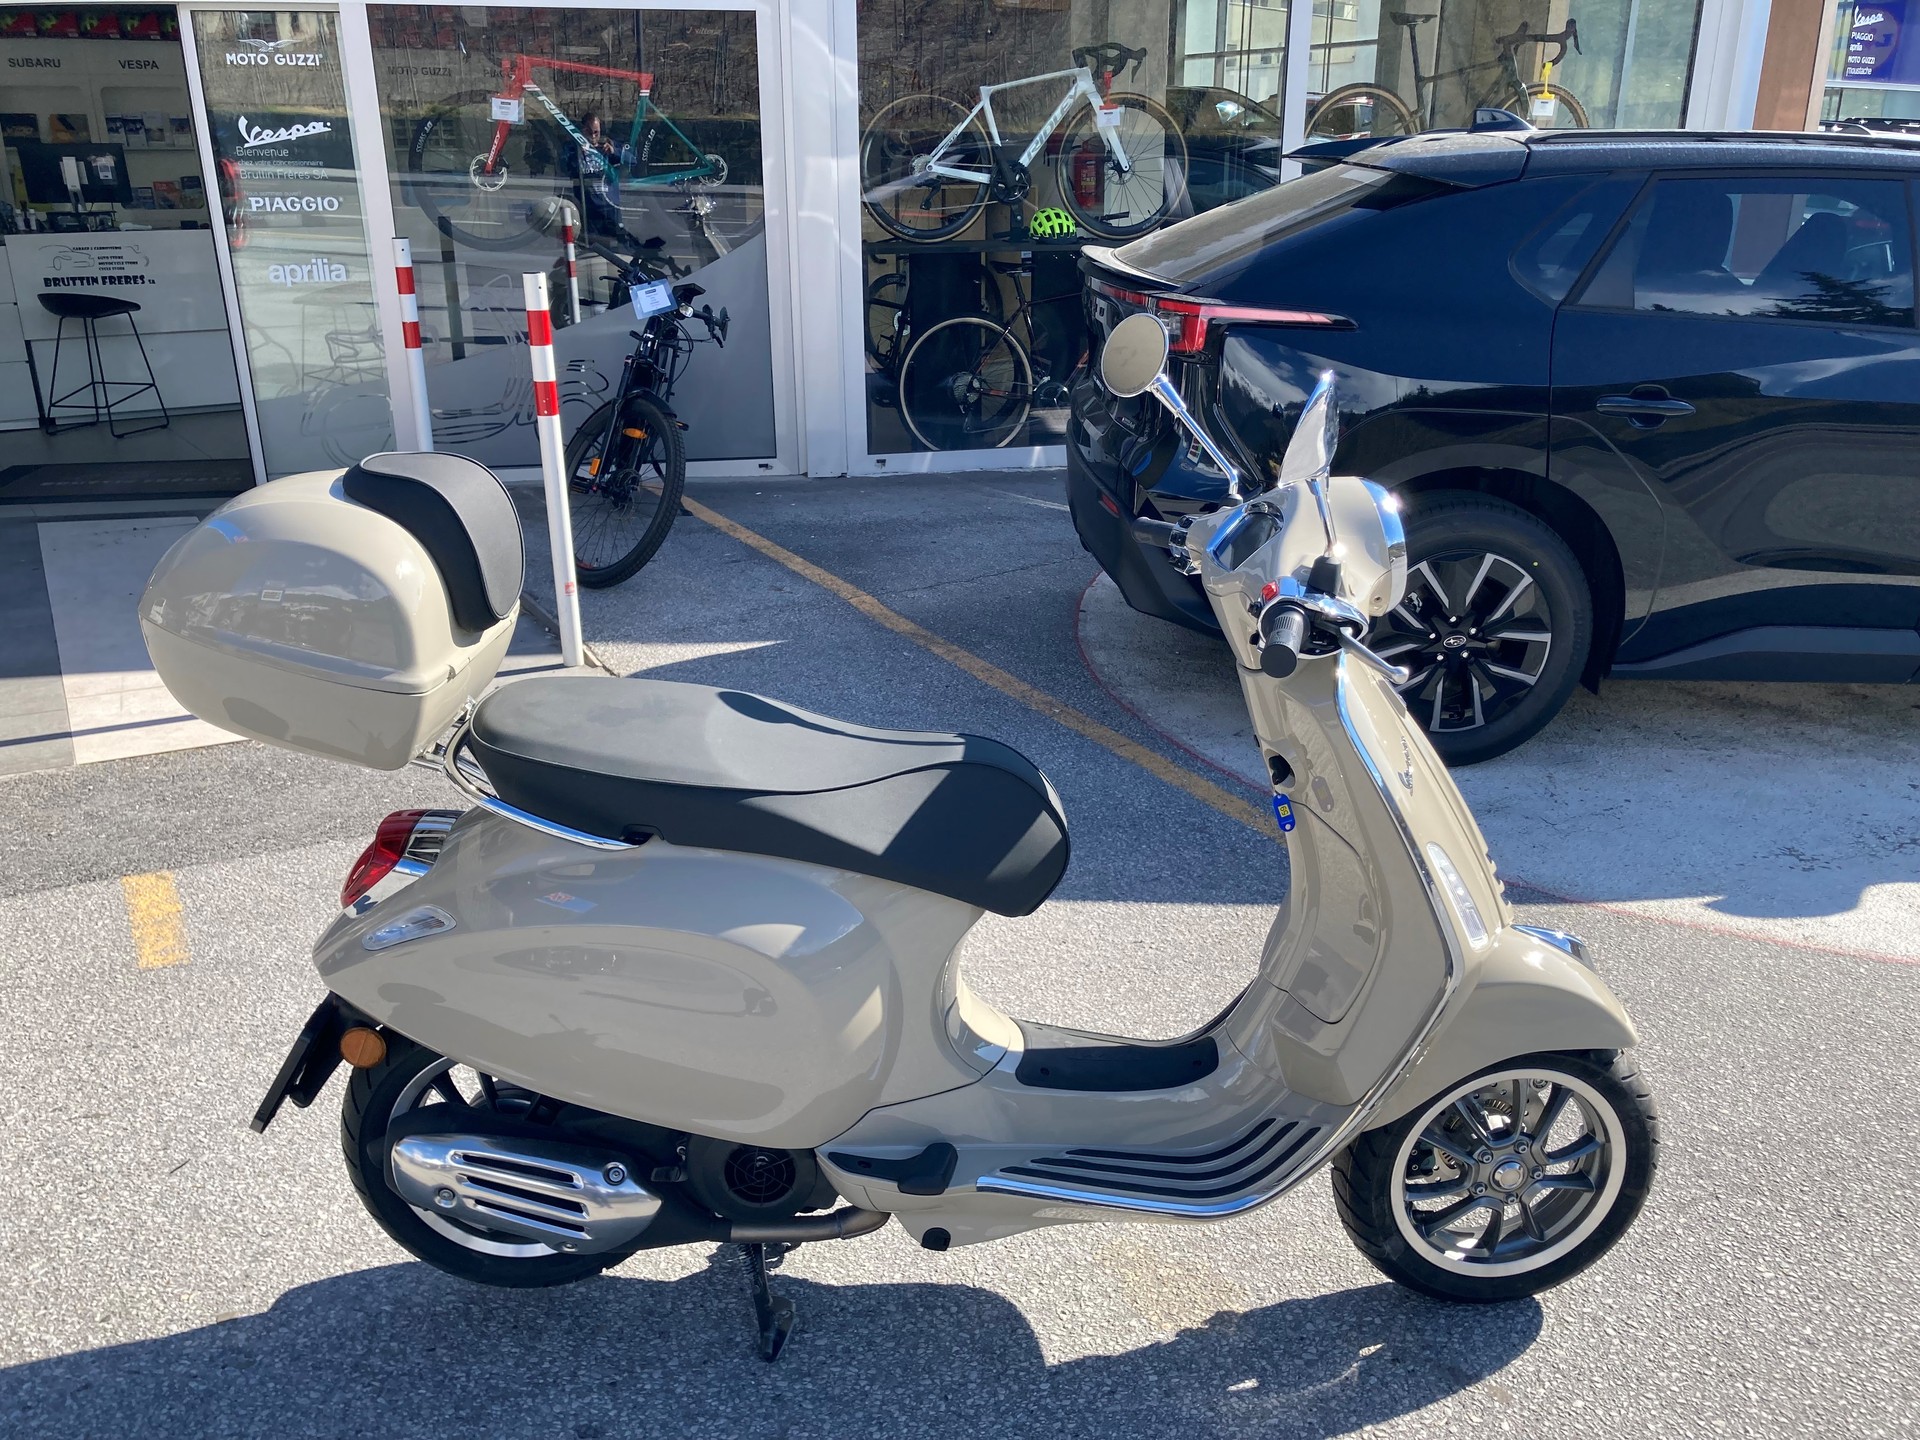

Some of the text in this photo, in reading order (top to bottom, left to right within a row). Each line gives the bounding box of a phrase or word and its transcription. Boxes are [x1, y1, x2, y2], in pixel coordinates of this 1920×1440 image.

[1853, 5, 1884, 28] Vespa
[1851, 32, 1873, 41] PIAGGIO
[8, 57, 62, 69] SUBARU
[118, 59, 160, 70] VESPA
[225, 53, 320, 67] MOTO GUZZI
[1862, 56, 1875, 64] GUZZI
[421, 67, 452, 78] GUZZI
[1846, 67, 1872, 76] moustache
[537, 95, 599, 154] RIDLEY
[237, 115, 332, 149] Vespa
[235, 146, 289, 157] Bienvenue
[312, 170, 329, 180] SA
[248, 196, 339, 212] PIAGGIO
[268, 258, 347, 288] aprilia
[43, 275, 99, 288] BRUTTIN
[101, 275, 146, 286] FRERES
